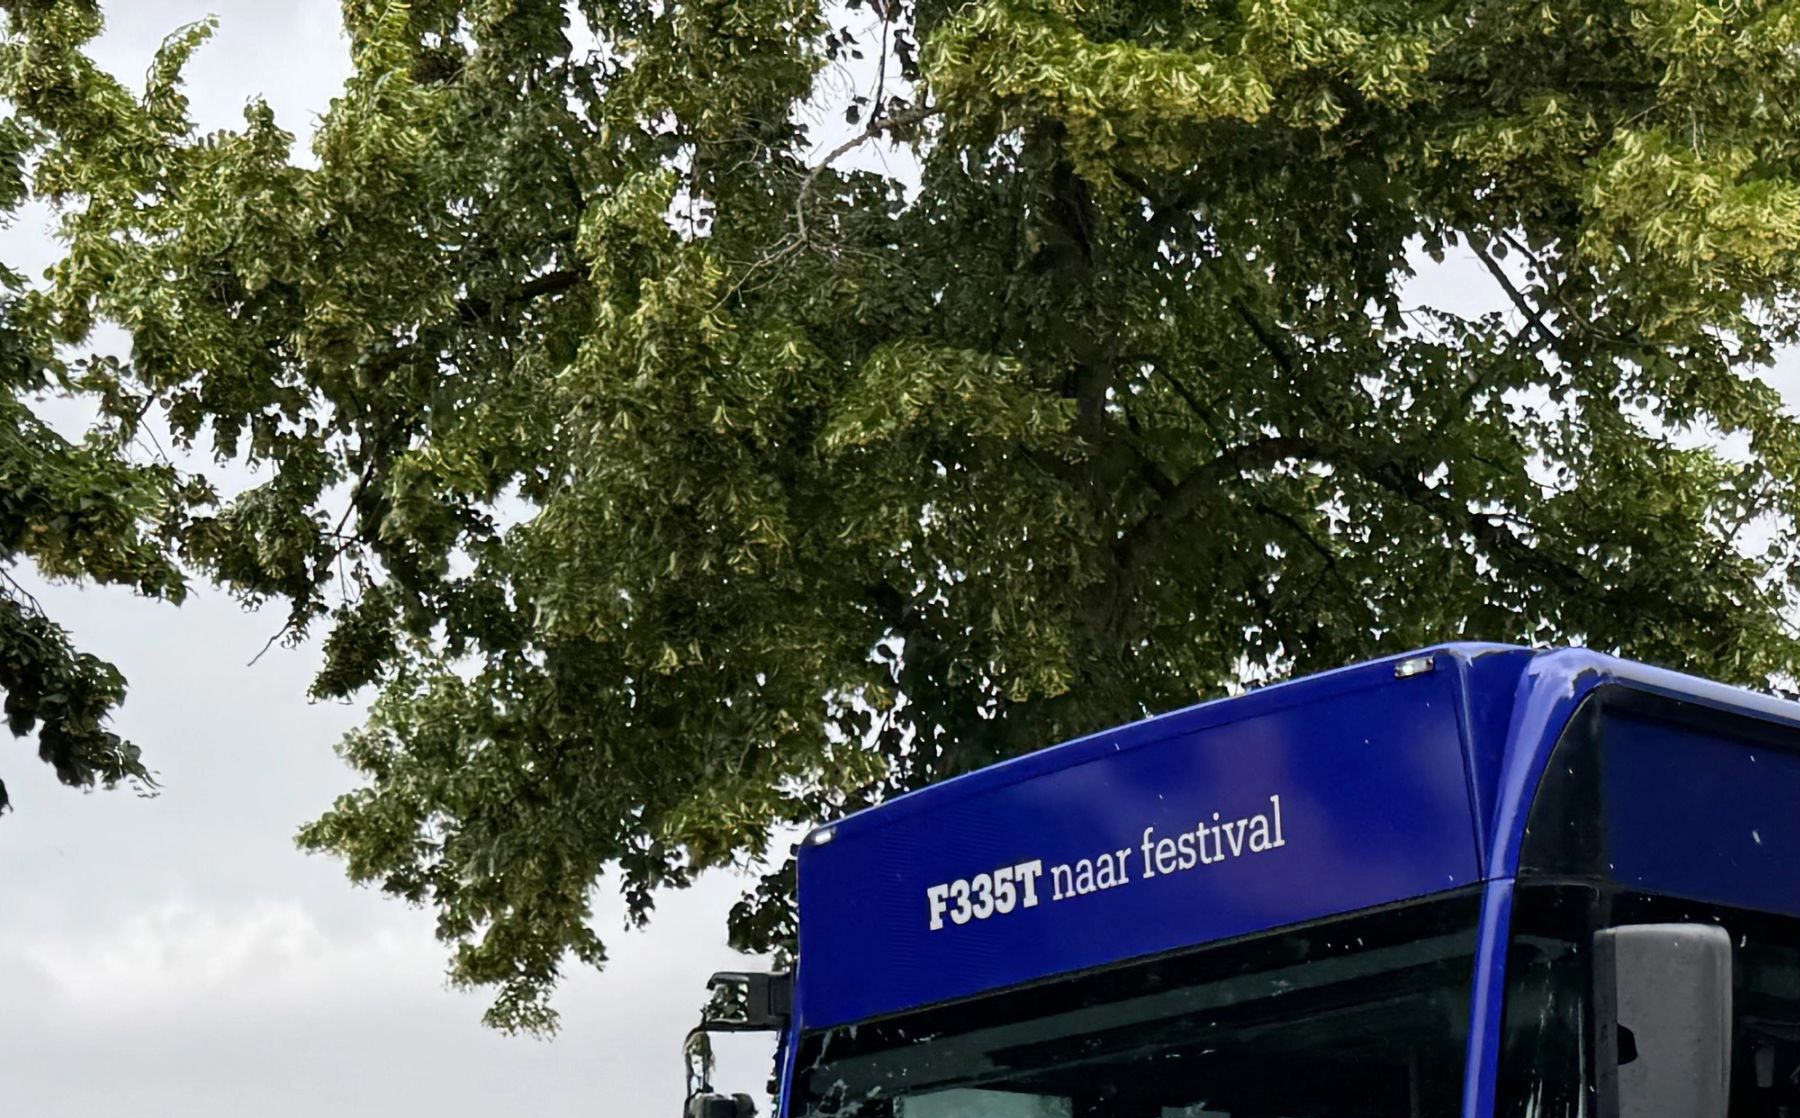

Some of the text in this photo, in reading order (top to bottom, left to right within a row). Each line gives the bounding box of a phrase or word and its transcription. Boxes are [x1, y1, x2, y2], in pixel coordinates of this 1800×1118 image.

[926, 794, 1286, 931] F335T naar festival
